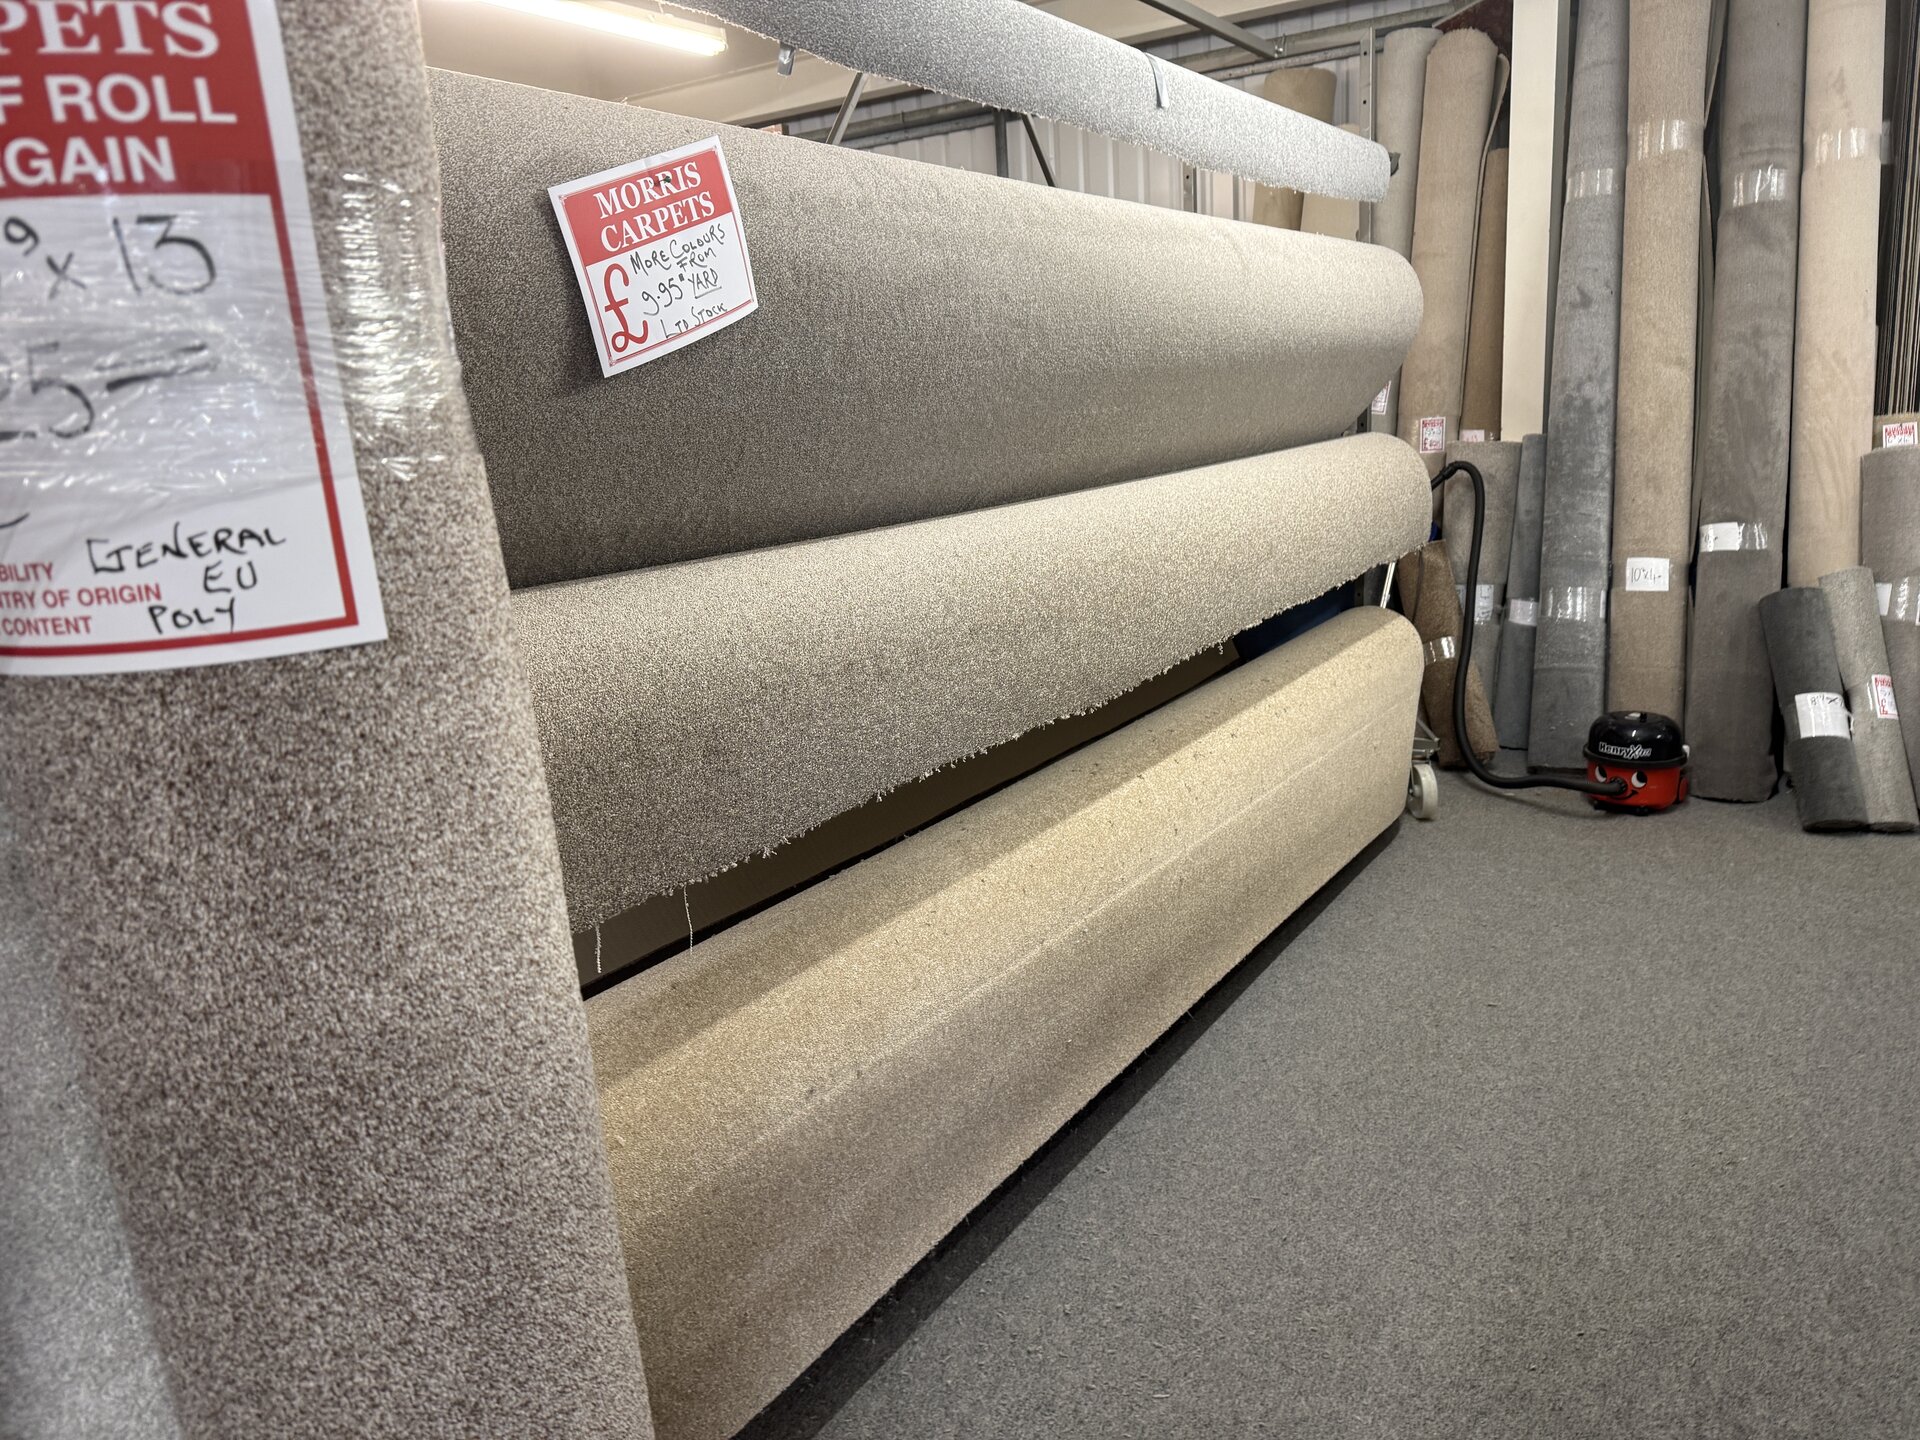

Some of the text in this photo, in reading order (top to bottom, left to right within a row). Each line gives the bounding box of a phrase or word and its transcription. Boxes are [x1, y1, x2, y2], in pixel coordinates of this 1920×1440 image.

[45, 74, 237, 124] ROLL
[0, 136, 176, 187] GAIN
[593, 161, 701, 219] MORRIS
[601, 191, 715, 252] CARPETS
[112, 215, 217, 295] 13
[630, 251, 671, 276] MORE
[676, 247, 717, 272] FROM
[603, 263, 649, 353] £
[688, 268, 720, 299] YARD
[691, 303, 728, 327] STOCK
[87, 521, 287, 574] GENERAL
[0, 583, 162, 609] TRY OF ORIGIN
[203, 561, 258, 593] EU
[2, 616, 92, 636] CONTENT
[149, 597, 235, 634] POLY
